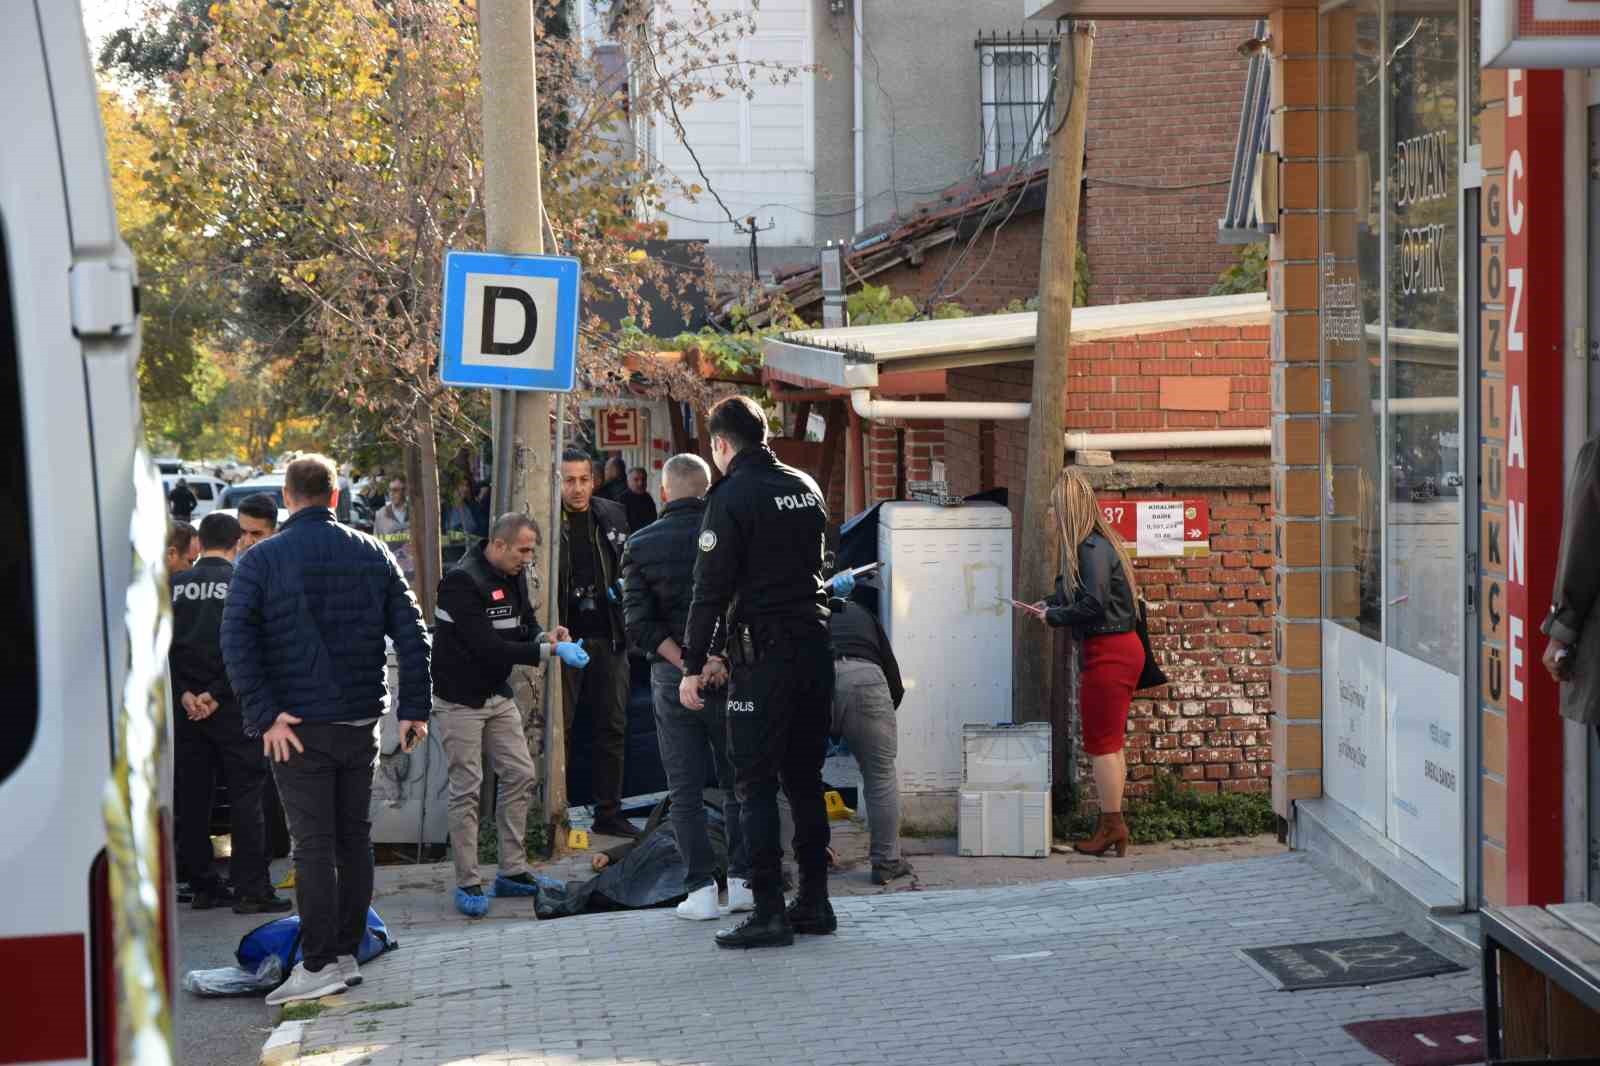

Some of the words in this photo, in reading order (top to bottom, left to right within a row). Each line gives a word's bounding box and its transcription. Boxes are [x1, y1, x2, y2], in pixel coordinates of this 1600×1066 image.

[1397, 129, 1448, 207] DUYAN
[480, 285, 538, 356] D
[1507, 69, 1526, 702] ECZANE
[607, 411, 631, 443] E
[1487, 183, 1502, 701] GÖZLÜKÇÜ
[1103, 506, 1124, 524] 37
